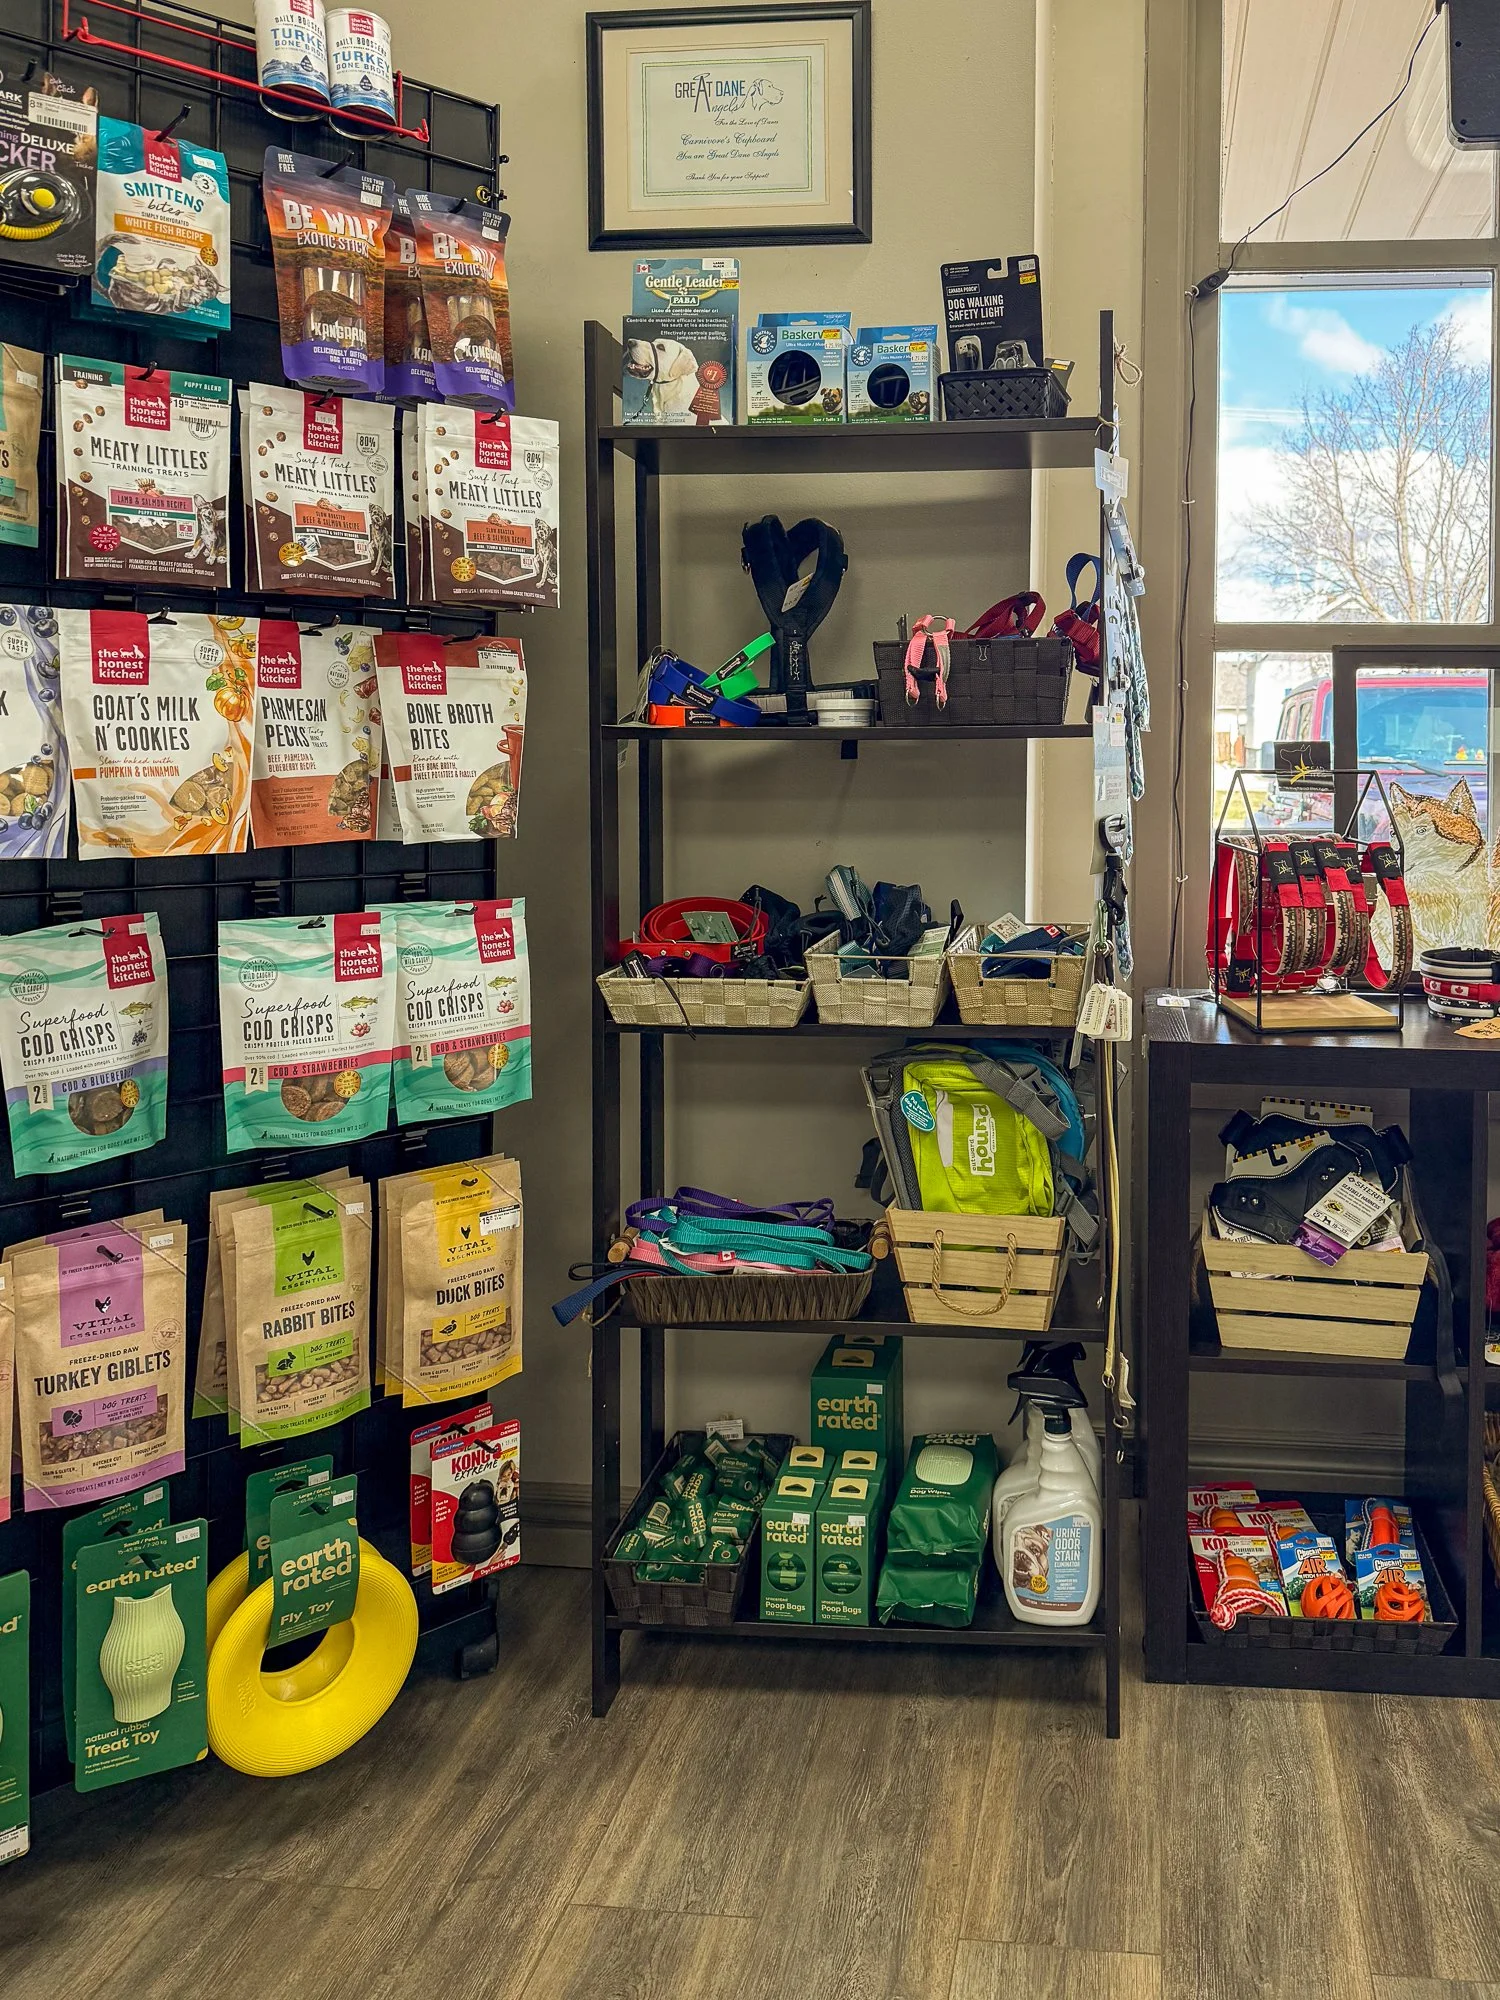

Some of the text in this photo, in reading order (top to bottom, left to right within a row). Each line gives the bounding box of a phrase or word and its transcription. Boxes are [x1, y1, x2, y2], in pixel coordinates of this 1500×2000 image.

[716, 80, 746, 97] DANE
[738, 118, 754, 126] Love
[20, 132, 75, 156] DELUXE
[681, 132, 778, 147] Carnivore's Cupboard
[278, 153, 294, 164] HIDE
[676, 150, 692, 161] You
[707, 149, 728, 160] Great
[730, 149, 750, 159] Dane
[753, 148, 779, 160] Angels
[279, 163, 296, 174] FREE
[686, 173, 705, 181] Thank
[707, 173, 720, 181] You
[124, 182, 205, 213] SMITTENS
[148, 199, 185, 216] bites
[417, 201, 432, 212] FREE
[125, 217, 175, 234] WHITE FISH
[645, 275, 683, 290] Gentle
[686, 275, 724, 290] Leader
[948, 286, 964, 295] CANADA
[672, 297, 697, 305] PABA
[948, 294, 1004, 311] DOG WALKING
[949, 306, 1005, 322] SAFETY LIGHT
[73, 370, 103, 382] TRAINING
[706, 369, 718, 382] #1
[184, 380, 222, 393] PUPPY BLEND
[129, 413, 167, 427] kitchen
[130, 405, 166, 419] honest
[91, 436, 209, 471] MEATY LITTLES
[111, 462, 190, 478] TRAINING TREATS
[274, 462, 378, 495] MEATY LITTLES
[449, 480, 543, 509] MEATY LITTLES
[97, 649, 119, 659] the
[199, 645, 219, 656] SUPER
[200, 652, 219, 663] TASTY
[98, 658, 143, 671] honest
[260, 655, 276, 665] the
[98, 668, 144, 681] kitchen
[259, 664, 297, 676] honest
[406, 664, 423, 674] the
[260, 673, 297, 685] kitchen
[407, 673, 442, 684] honest
[408, 681, 444, 691] kitchen
[93, 694, 200, 722] GOAT'S MILK
[261, 696, 327, 722] PARMESAN
[406, 702, 494, 725] BONE BROTH
[116, 726, 190, 752] COOKIES
[265, 723, 310, 748] PECKS
[411, 728, 451, 751] BITES
[98, 756, 174, 767] Slow baked with
[412, 754, 441, 764] Roasted
[99, 765, 180, 780] PUMPKIN & CINNAMON
[404, 975, 480, 1001] Superfood
[240, 994, 332, 1020] Superfood
[407, 992, 485, 1022] COD CRISPS
[243, 1013, 334, 1043] COD CRISPS
[21, 1021, 117, 1060] COD CRISPS
[244, 1034, 335, 1050] CRISPY SNACKS
[301, 1058, 360, 1077] STRAWBERRIES
[250, 1067, 258, 1086] 2
[33, 1085, 42, 1105] 2
[971, 1103, 994, 1173] hound
[1354, 1179, 1388, 1205] SHERPA
[285, 1265, 335, 1282] VITAL
[281, 1274, 340, 1291] ESSENTIALS
[436, 1273, 506, 1306] DUCK BITES
[280, 1294, 342, 1314] FREEZE-DRIED RAW
[72, 1313, 134, 1331] VITAL
[262, 1300, 356, 1340] RABBIT BITES
[69, 1322, 137, 1345] ESSENTIALS
[69, 1346, 140, 1367] FREEZE-DRIED RAW
[34, 1350, 172, 1398] TURKEY GIBLETS
[101, 1392, 149, 1411] DOG TREATS
[816, 1395, 878, 1415] earth
[817, 1411, 882, 1431] rated
[500, 1427, 518, 1440] CHEWERS
[454, 1459, 499, 1482] EXTREME
[695, 1502, 707, 1533] earth
[766, 1532, 808, 1545] rated
[820, 1534, 864, 1547] rated
[1055, 1527, 1081, 1539] URINE
[1054, 1538, 1082, 1552] ODOR
[280, 1538, 353, 1578] earth
[1054, 1550, 1082, 1566] STAIN
[1296, 1547, 1322, 1561] Chuckit!
[1298, 1558, 1329, 1575] AIR
[1374, 1558, 1404, 1572] Chuckit!
[85, 1570, 141, 1598] earth
[282, 1559, 353, 1597] rated
[1373, 1569, 1407, 1585] AIR
[280, 1599, 336, 1628] Fly Toy
[765, 1601, 807, 1614] Poop Bags
[820, 1604, 863, 1617] Poop Bags
[85, 1720, 151, 1746] natural rubber
[84, 1727, 161, 1760] Treat Toy
